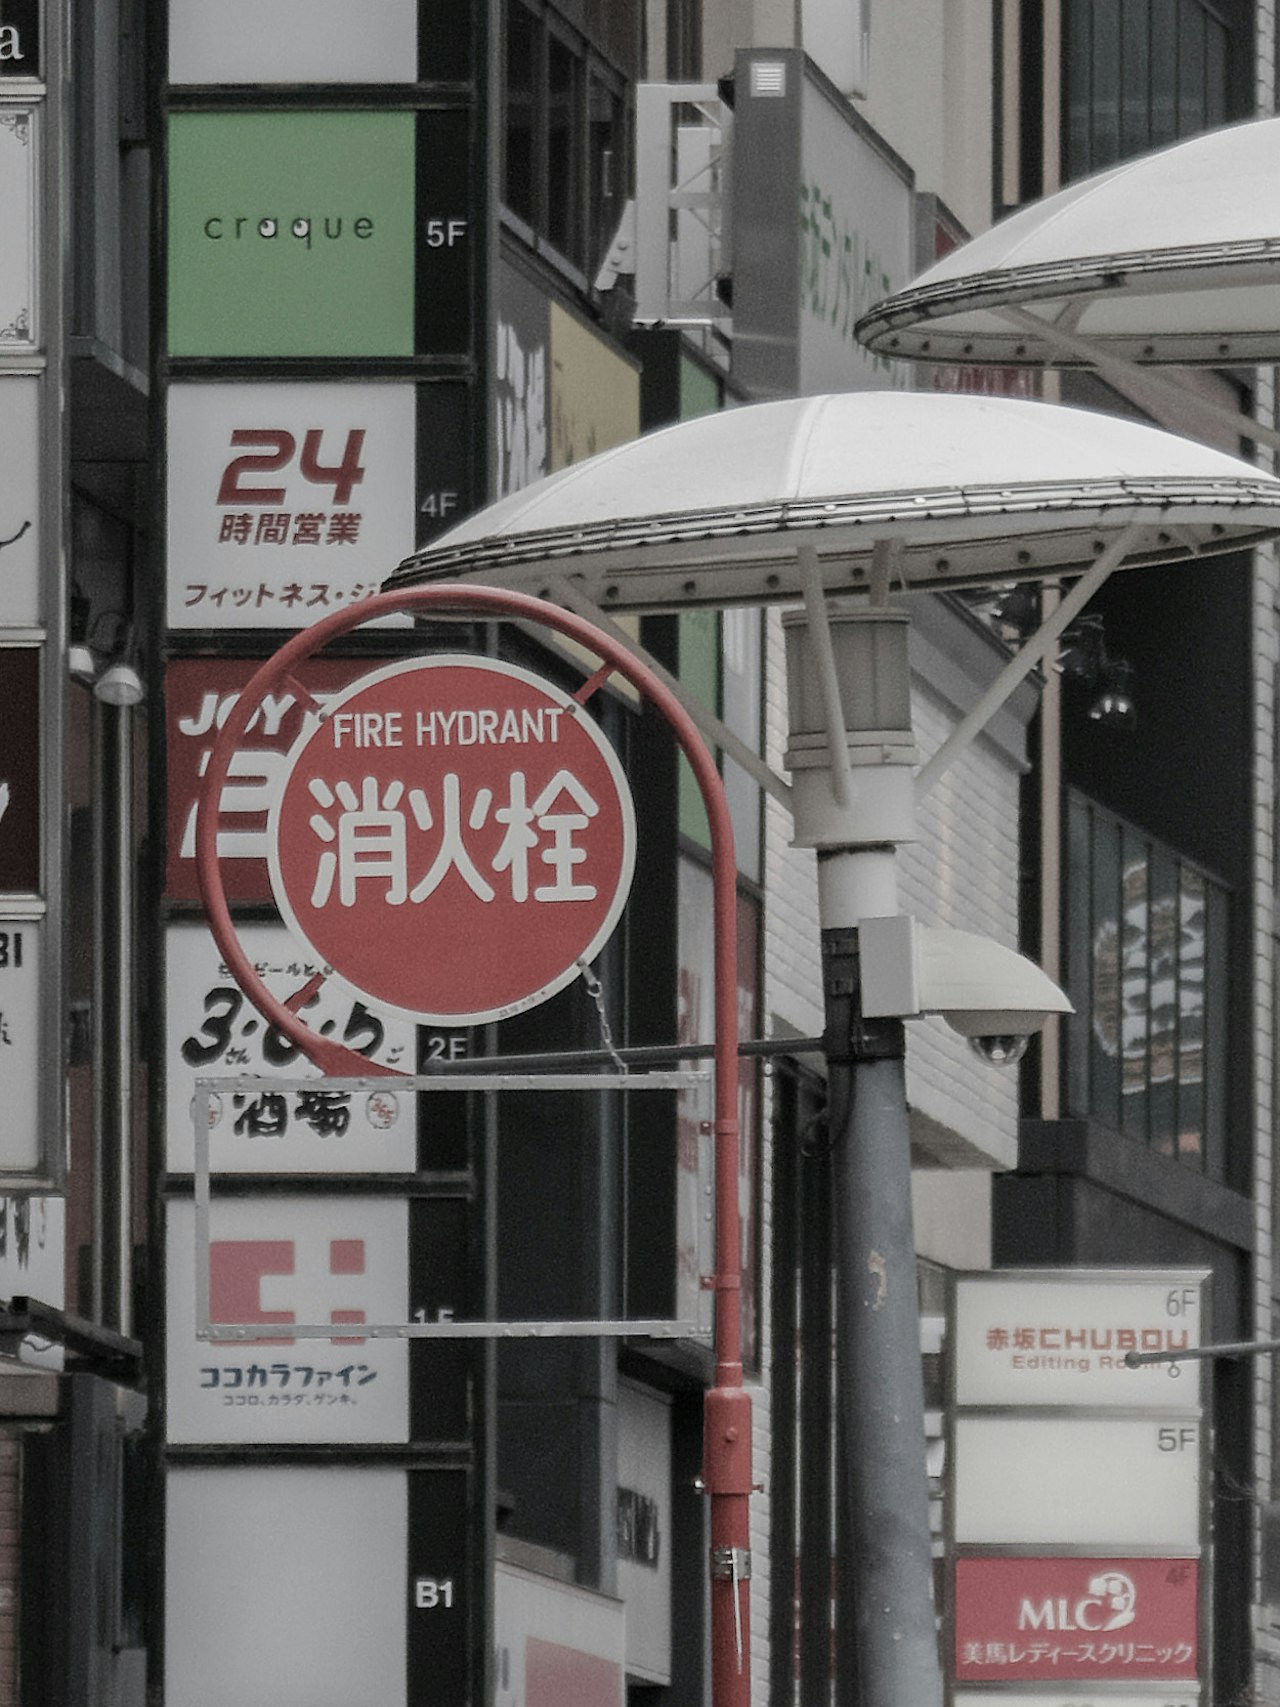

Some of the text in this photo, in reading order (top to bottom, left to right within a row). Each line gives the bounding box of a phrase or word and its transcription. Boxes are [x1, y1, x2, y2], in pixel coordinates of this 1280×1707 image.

[204, 214, 374, 249] craque
[426, 220, 467, 247] 5F
[217, 429, 365, 505] 24
[421, 495, 457, 518] 4F
[217, 513, 362, 546] 時間営業
[333, 708, 562, 748] FIRE HYDRANT
[309, 772, 599, 907] 消火栓
[1166, 1290, 1194, 1317] 6F
[200, 1364, 378, 1389] ココカラファイン
[1012, 1356, 1090, 1372] Editing
[1158, 1428, 1195, 1452] 5F
[415, 1582, 453, 1607] B1
[1018, 1600, 1101, 1630] MLC
[962, 1643, 1193, 1665] 美馬レディースクリニック
